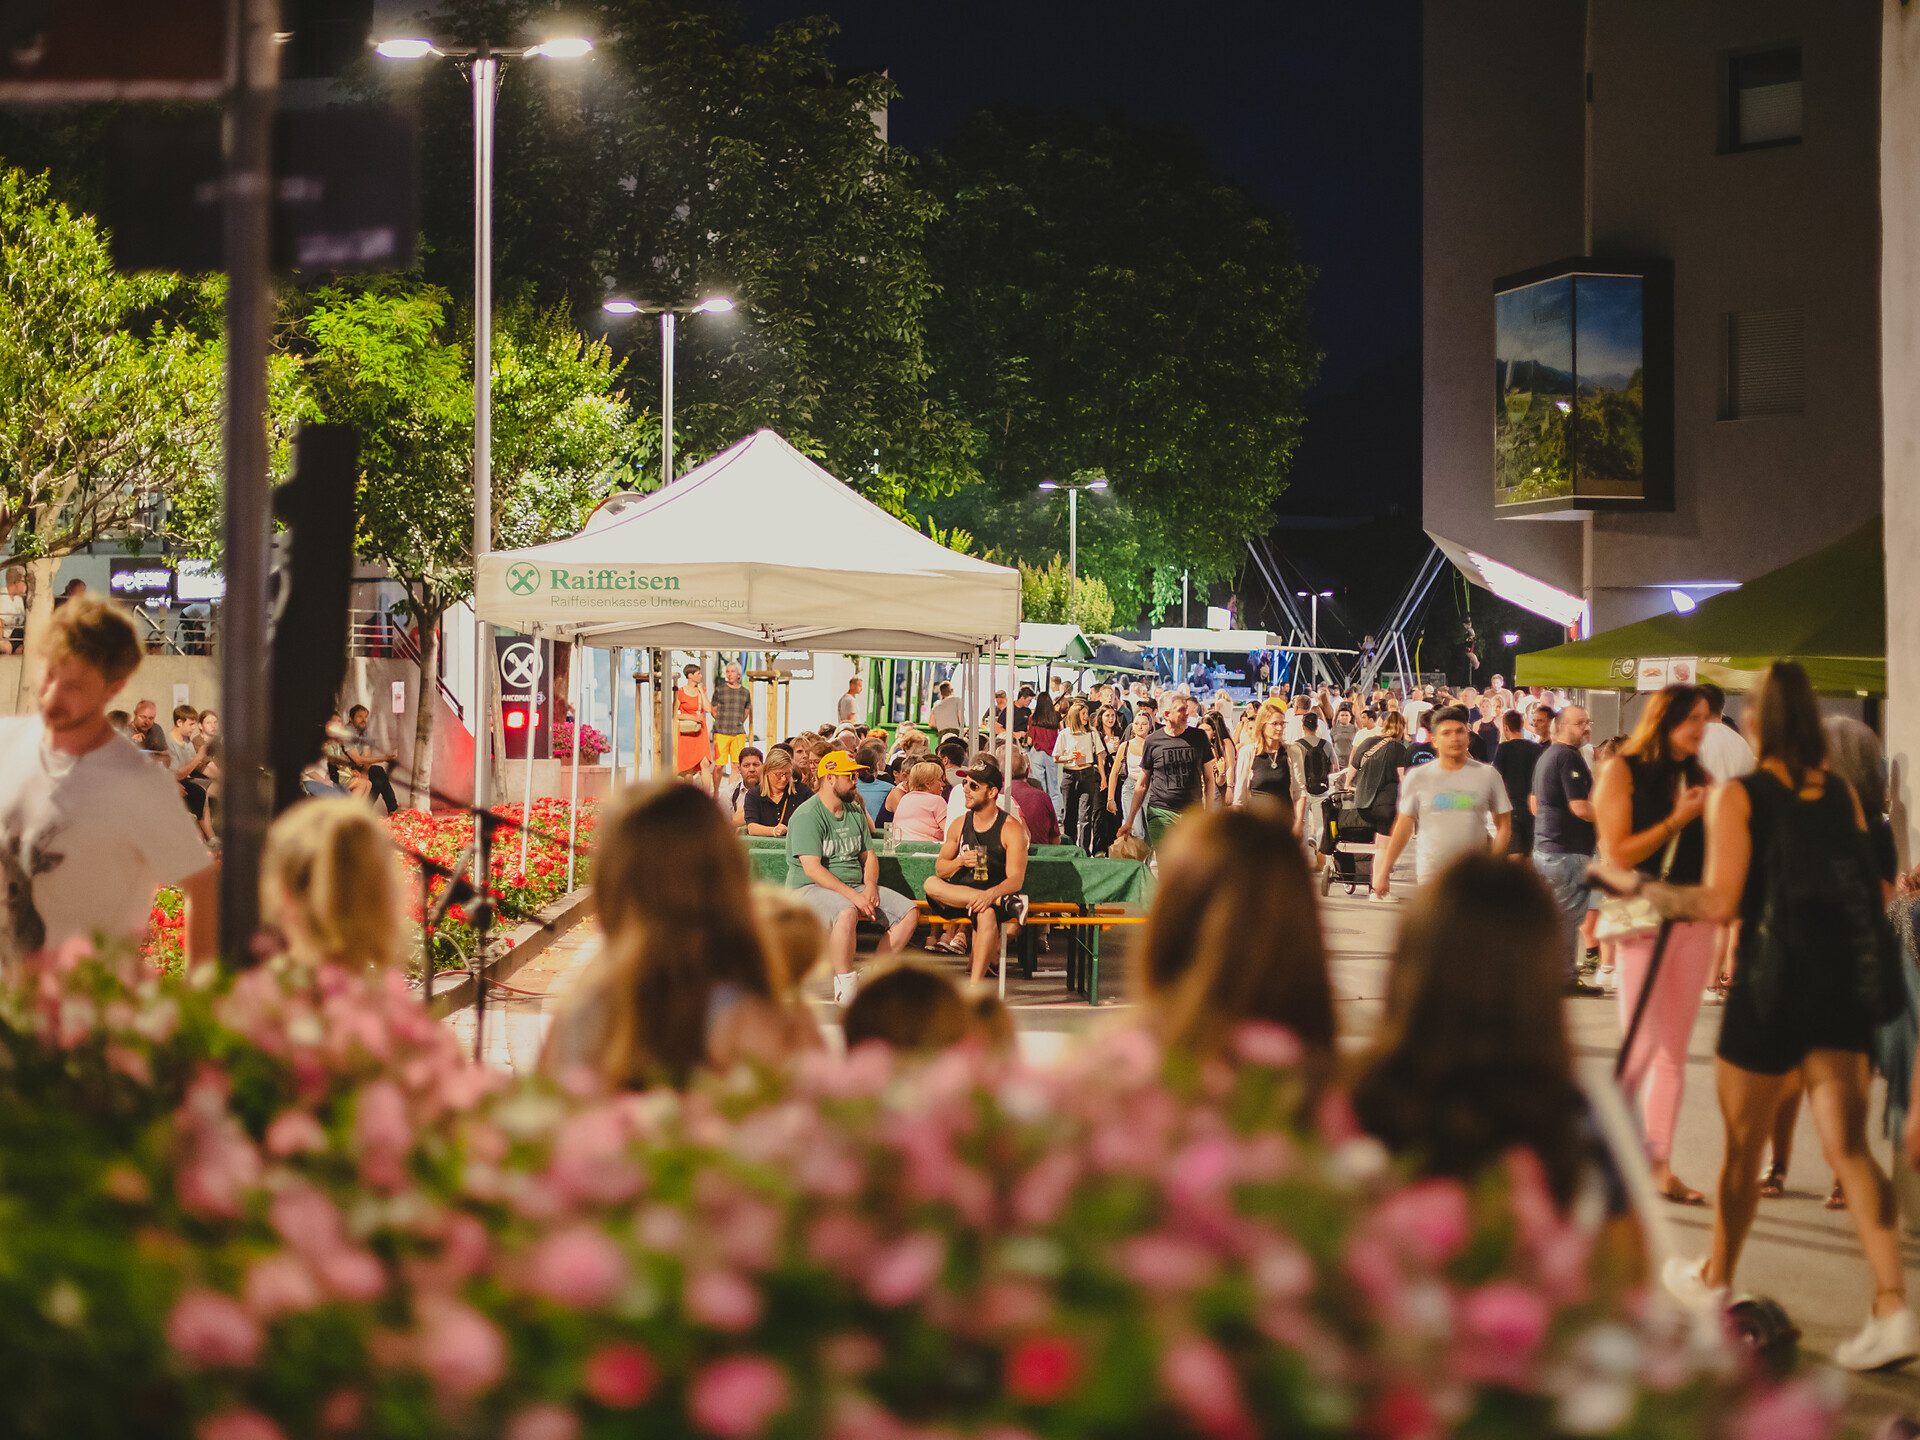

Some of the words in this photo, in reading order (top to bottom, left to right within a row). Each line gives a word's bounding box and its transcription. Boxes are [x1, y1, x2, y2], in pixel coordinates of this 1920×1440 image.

[550, 569, 681, 590] Raiffeisen
[551, 595, 647, 608] Raiffeisenkasse
[651, 596, 745, 610] Untervinschgau
[501, 694, 532, 702] ANCOMAT
